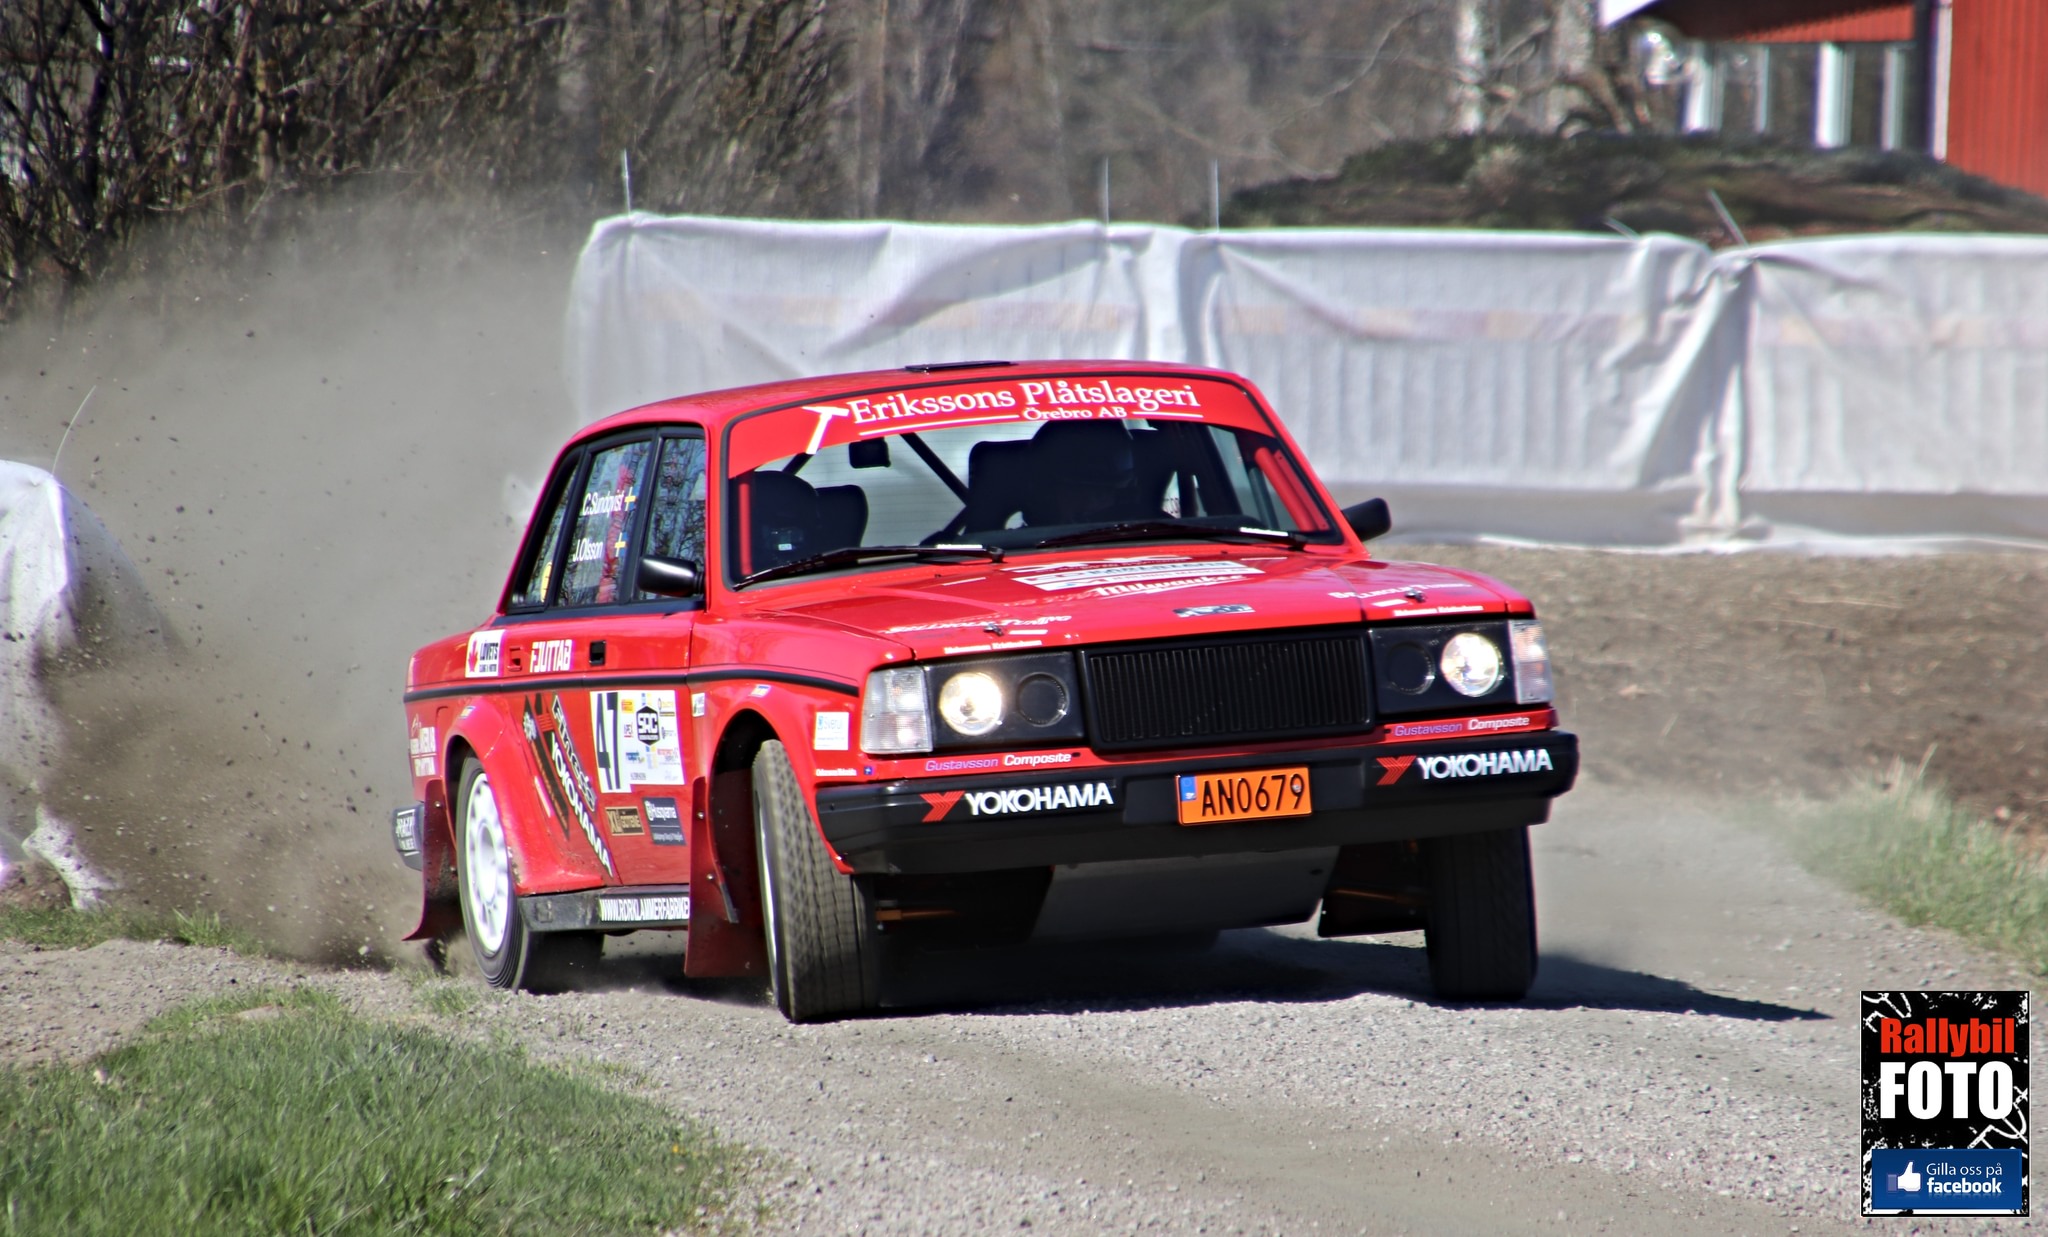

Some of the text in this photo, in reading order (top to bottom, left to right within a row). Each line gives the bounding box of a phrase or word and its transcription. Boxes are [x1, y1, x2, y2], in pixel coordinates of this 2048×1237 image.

[847, 379, 1202, 424] Erikssons Plåtslageri
[1023, 405, 1128, 421] Örebro AB
[596, 691, 621, 790] 47
[1394, 716, 1530, 737] Gustavsson Composite
[925, 752, 1072, 772] Gustavsson Composite
[1417, 748, 1554, 780] YOKOHAMA
[551, 731, 614, 878] YOKOHAMA
[965, 782, 1114, 816] YOKOHAMA
